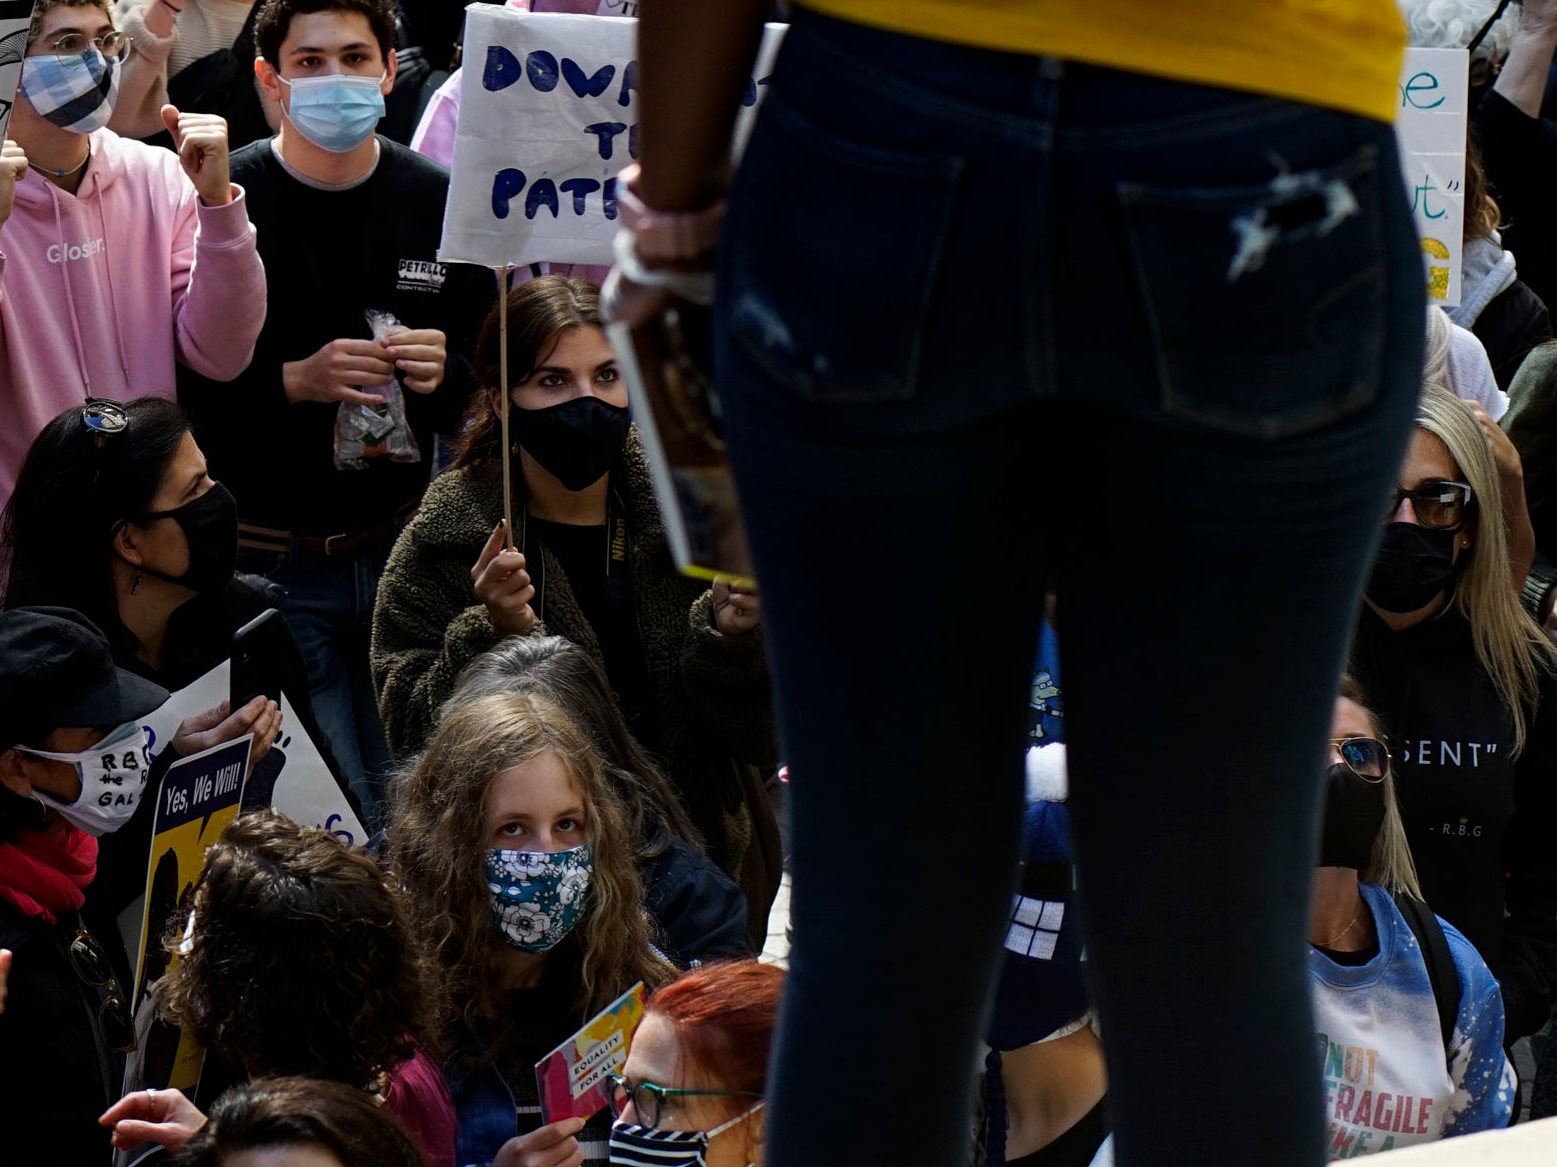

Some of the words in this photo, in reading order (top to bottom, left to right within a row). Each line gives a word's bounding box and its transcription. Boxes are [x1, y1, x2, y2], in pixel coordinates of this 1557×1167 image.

[611, 517, 627, 561] Nikon
[98, 773, 124, 786] the
[165, 785, 189, 816] Yes,
[192, 774, 212, 806] We
[213, 762, 242, 798] Will!
[573, 1034, 620, 1076] EQUALITY
[580, 1072, 599, 1091] FOR
[601, 1058, 619, 1074] ALL
[1324, 1041, 1379, 1086] NOT
[1323, 1080, 1433, 1134] FRAGILE
